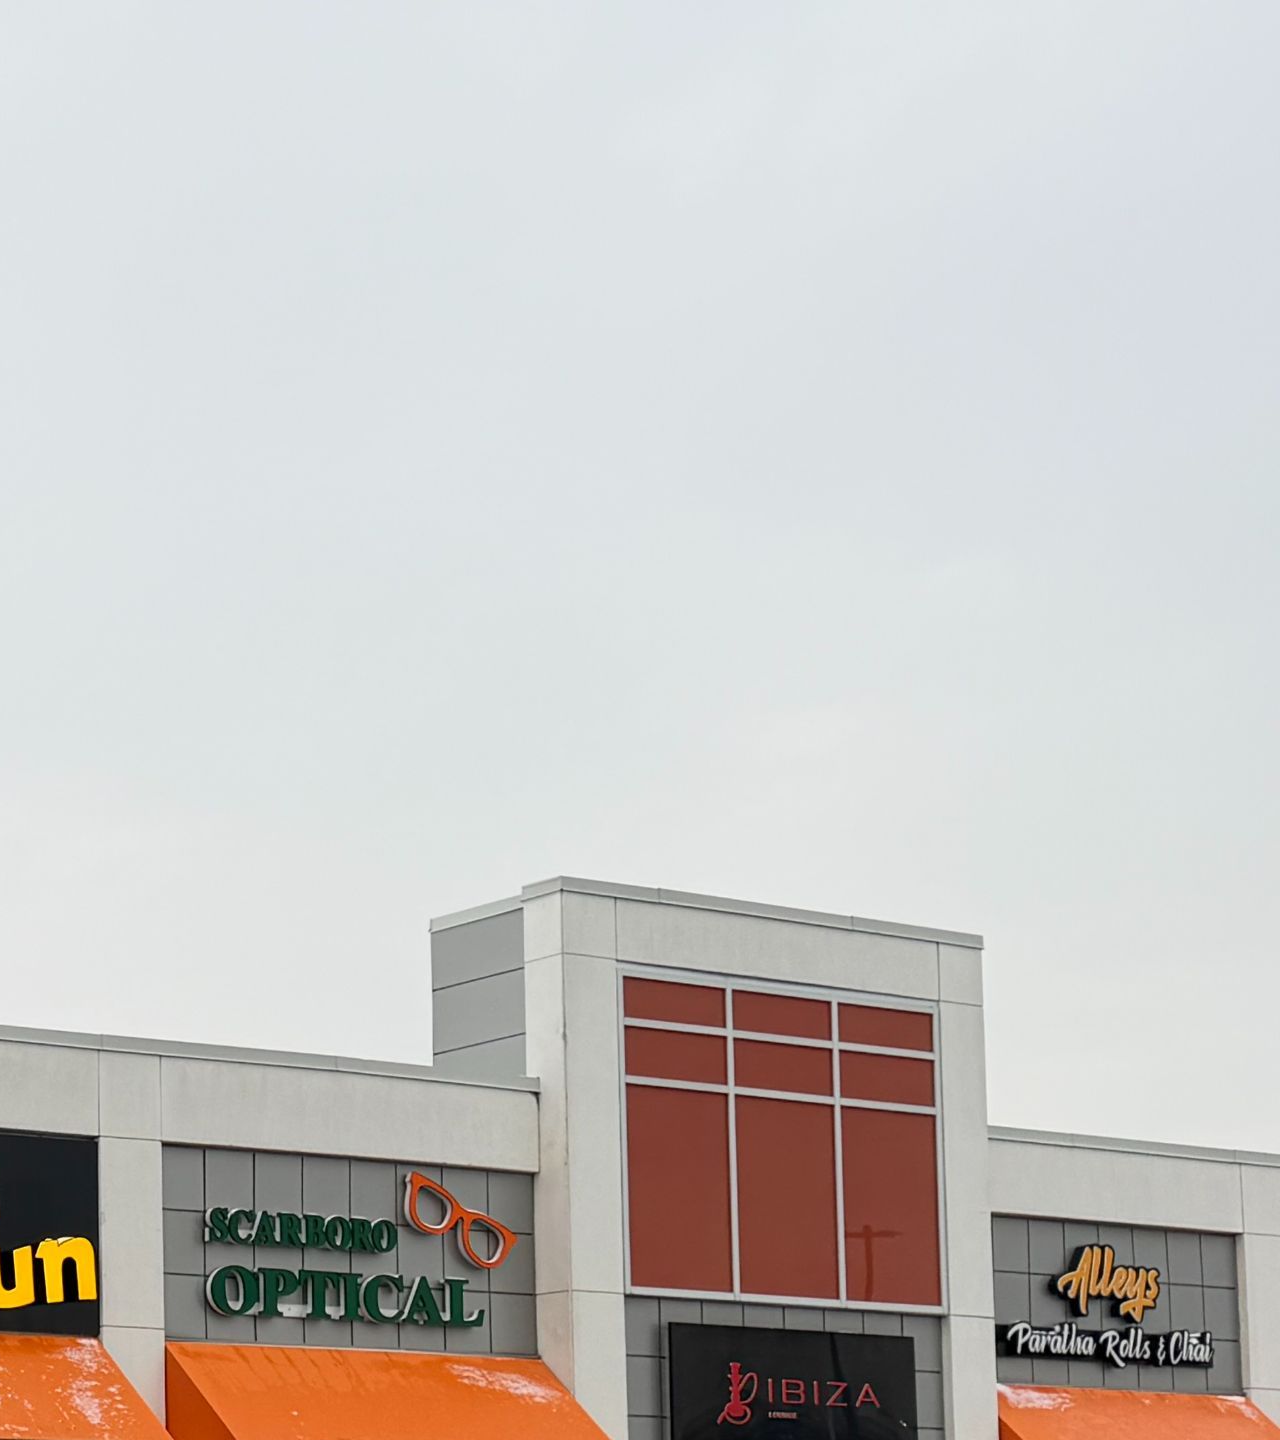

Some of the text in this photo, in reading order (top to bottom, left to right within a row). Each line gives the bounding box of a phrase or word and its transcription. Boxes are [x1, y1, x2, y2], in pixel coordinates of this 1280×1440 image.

[205, 1206, 398, 1253] SCARBORO
[206, 1264, 485, 1328] OPTICAL
[1057, 1245, 1161, 1322] Alleys
[1006, 1322, 1214, 1368] Paratha Rolls & Chai
[767, 1378, 881, 1409] IBIZA
